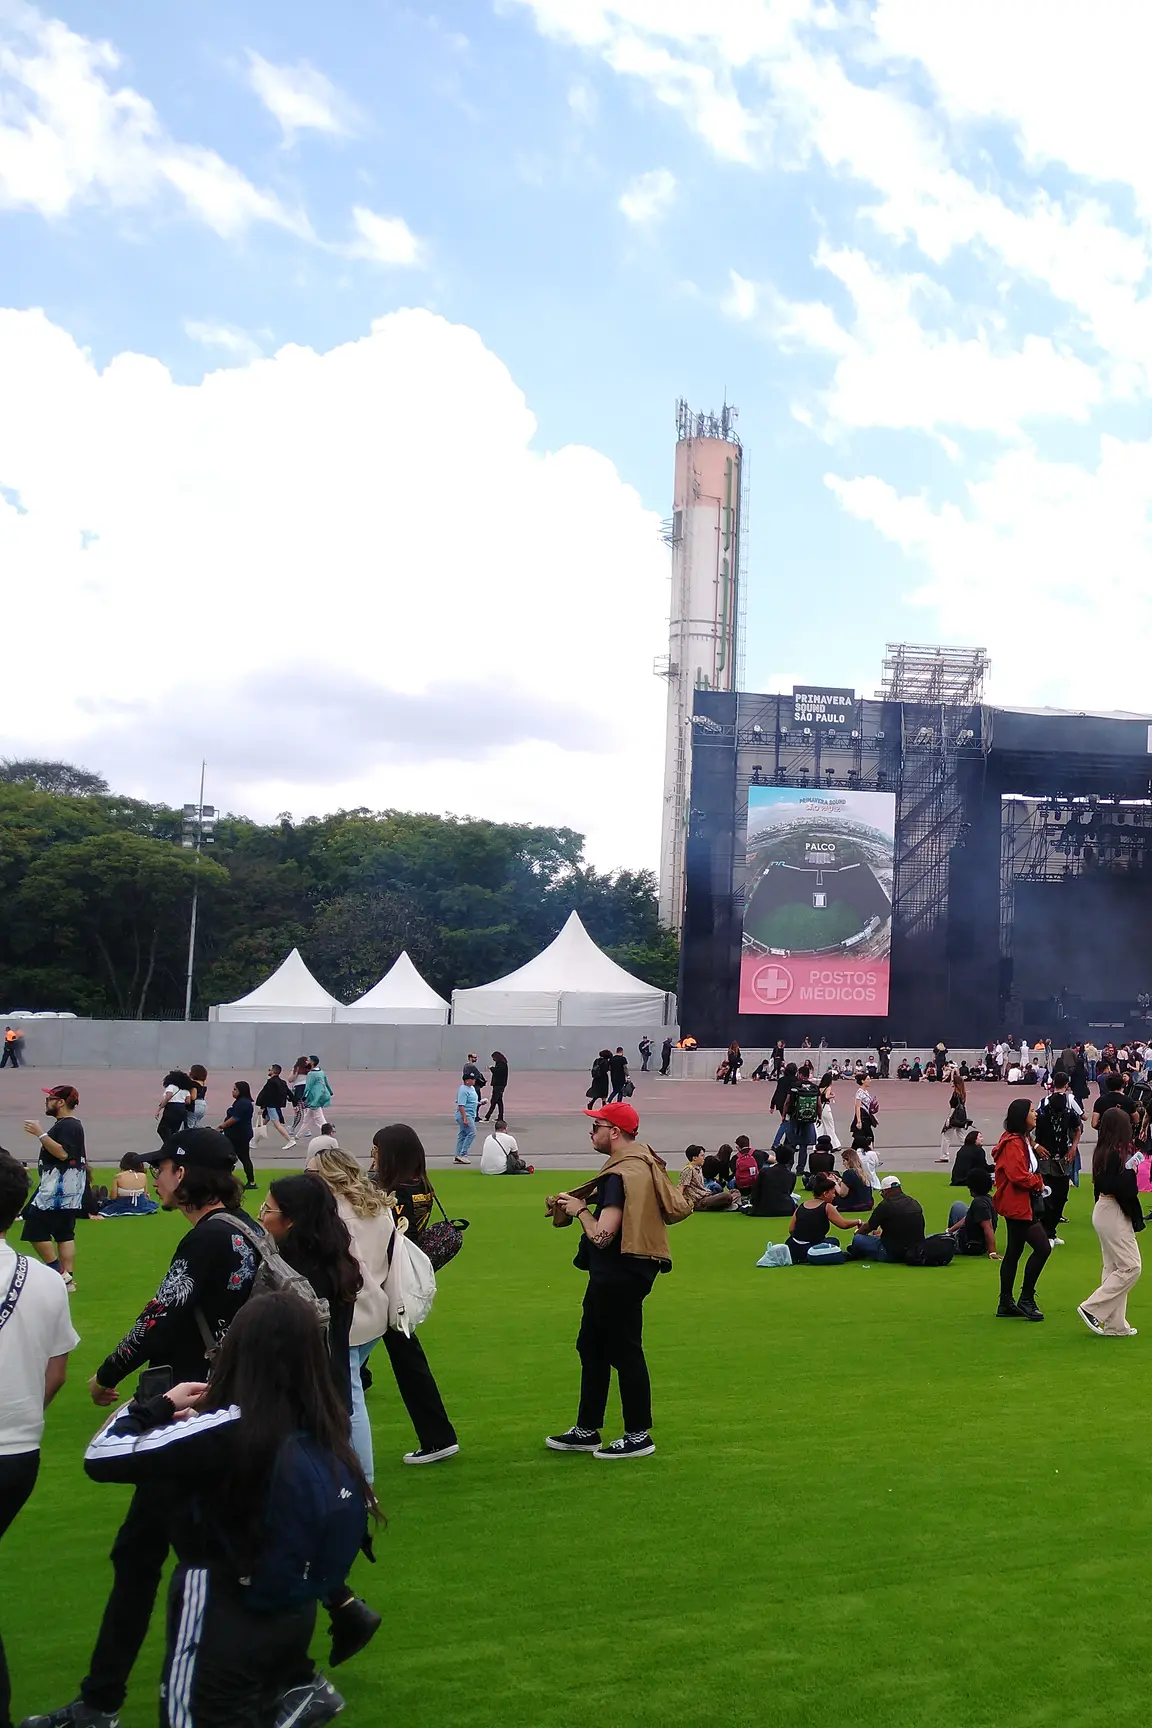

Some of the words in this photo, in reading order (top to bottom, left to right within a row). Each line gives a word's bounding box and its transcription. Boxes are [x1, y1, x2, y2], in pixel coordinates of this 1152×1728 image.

[795, 693, 852, 706] PRIMAVERA
[795, 703, 826, 713] SOUND
[794, 711, 813, 722] SÃO
[815, 713, 845, 723] PAULO
[805, 842, 836, 851] PALCO
[809, 970, 877, 985] POSTOS
[800, 984, 876, 1001] MÉDICOS
[14, 1256, 28, 1288] adidas
